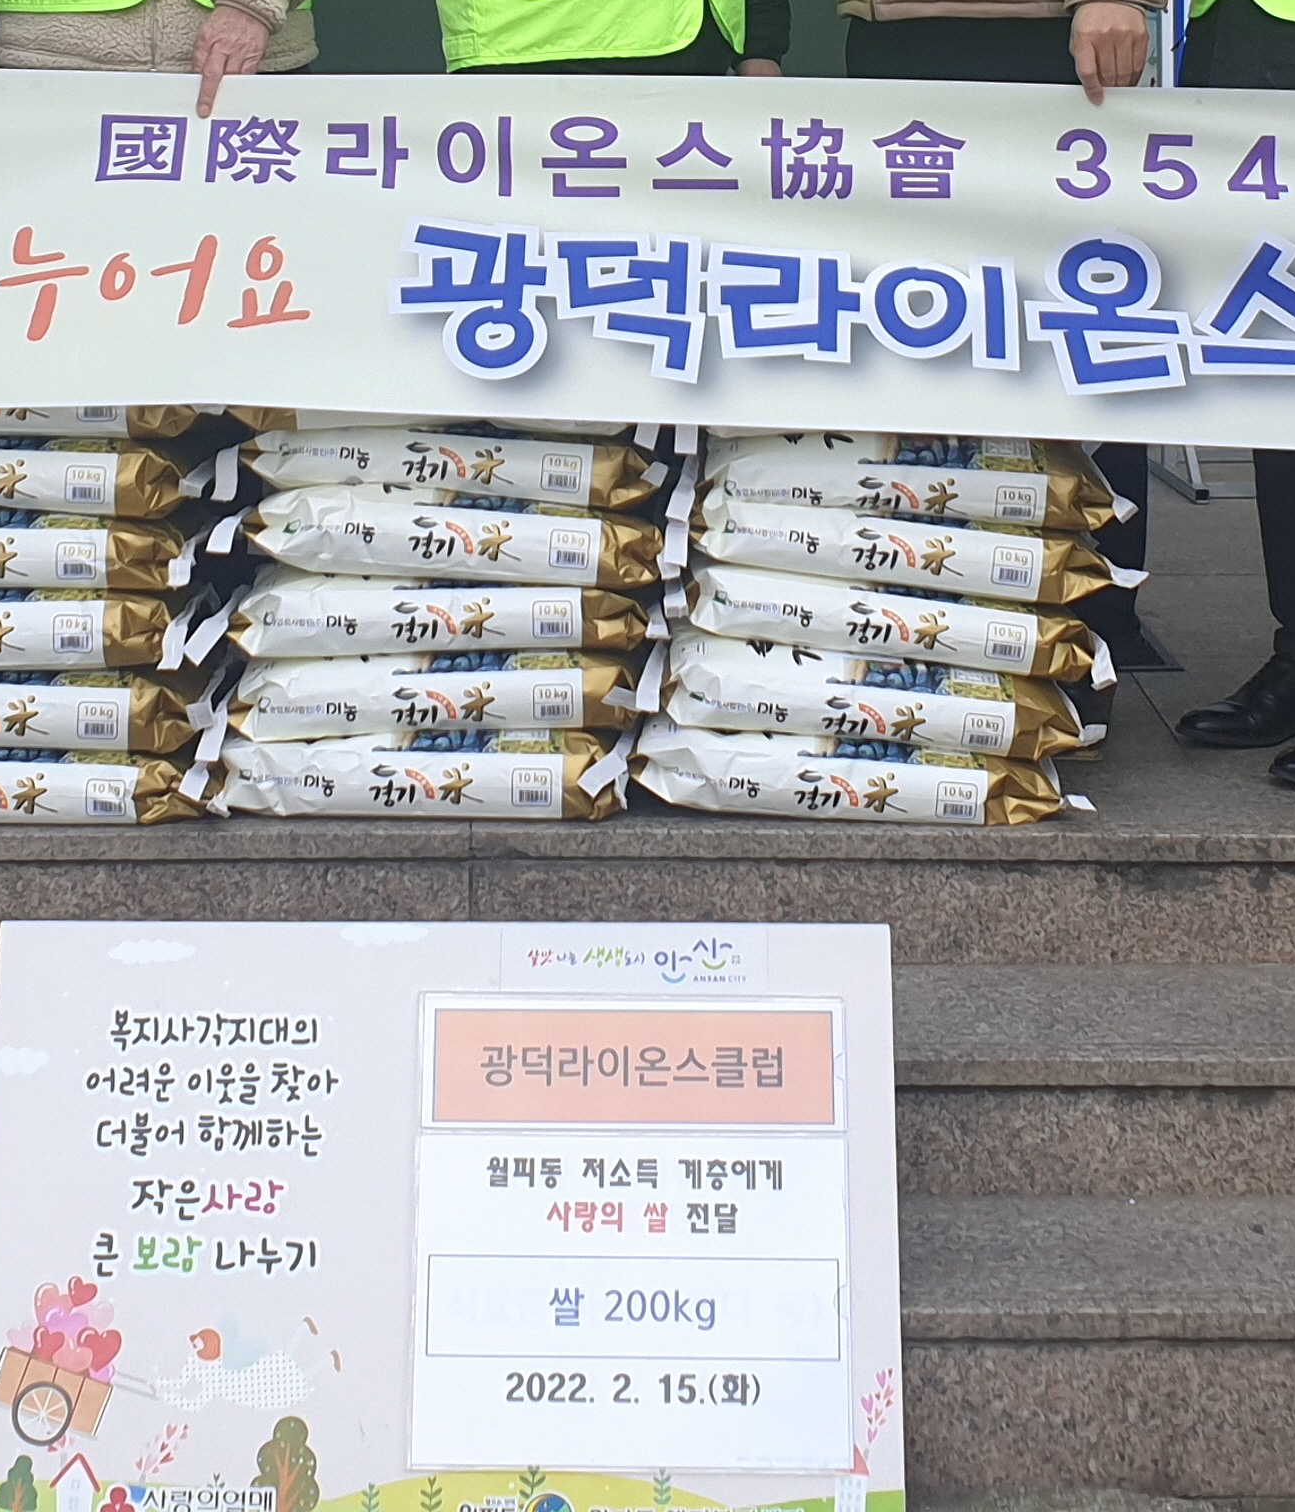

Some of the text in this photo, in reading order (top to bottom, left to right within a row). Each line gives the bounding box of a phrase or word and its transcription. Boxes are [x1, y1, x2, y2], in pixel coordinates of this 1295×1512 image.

[94, 113, 969, 201] 國際라이온스協會
[339, 446, 370, 469] 미농
[402, 455, 448, 483] 경기
[548, 457, 577, 471] 10 kg
[70, 470, 100, 484] 10 kg
[791, 487, 823, 506] 미농
[1001, 489, 1032, 504] 10 kg
[344, 522, 375, 544] 미농
[408, 530, 456, 560] 경기
[556, 532, 585, 547] 10 kg
[788, 529, 820, 554] 미농
[852, 542, 900, 571] 경기
[62, 545, 93, 559] 10 kg
[999, 549, 1028, 566] 10 kg
[537, 605, 567, 619] 10 kg
[782, 603, 813, 628] 미농
[845, 618, 892, 644] 경기
[59, 617, 88, 632] 10 kg
[326, 615, 358, 636] 미농
[391, 615, 439, 643] 경기
[993, 626, 1022, 642] 10 kg
[537, 688, 568, 702] 10 kg
[83, 706, 114, 720] 10 kg
[326, 702, 358, 722] 미농
[391, 702, 438, 726] 경기
[757, 702, 789, 723] 미농
[969, 717, 1000, 732] 10 kg
[92, 783, 121, 797] 10 kg
[304, 774, 336, 797] 미농
[368, 783, 416, 808] 경기
[517, 772, 547, 787] 10 kg
[728, 776, 761, 799] 미농
[793, 785, 841, 811] 경기
[942, 785, 972, 800] 10 kg
[110, 1009, 318, 1052] 복지사각지대의
[480, 1044, 785, 1089] 광덕라이온스클럽
[86, 1062, 339, 1105] 어려운 이웃을 찾아
[97, 1113, 322, 1157] 더불어 함께하는
[486, 1156, 783, 1191] 월피동 저소득 계층에게
[546, 1201, 739, 1235] 사랑의 쌀 전달
[92, 1232, 317, 1277] 큰 보람 나누기
[549, 1287, 717, 1330] 쌀 200kg
[505, 1372, 762, 1407] 2022. 2. 15.(화)
